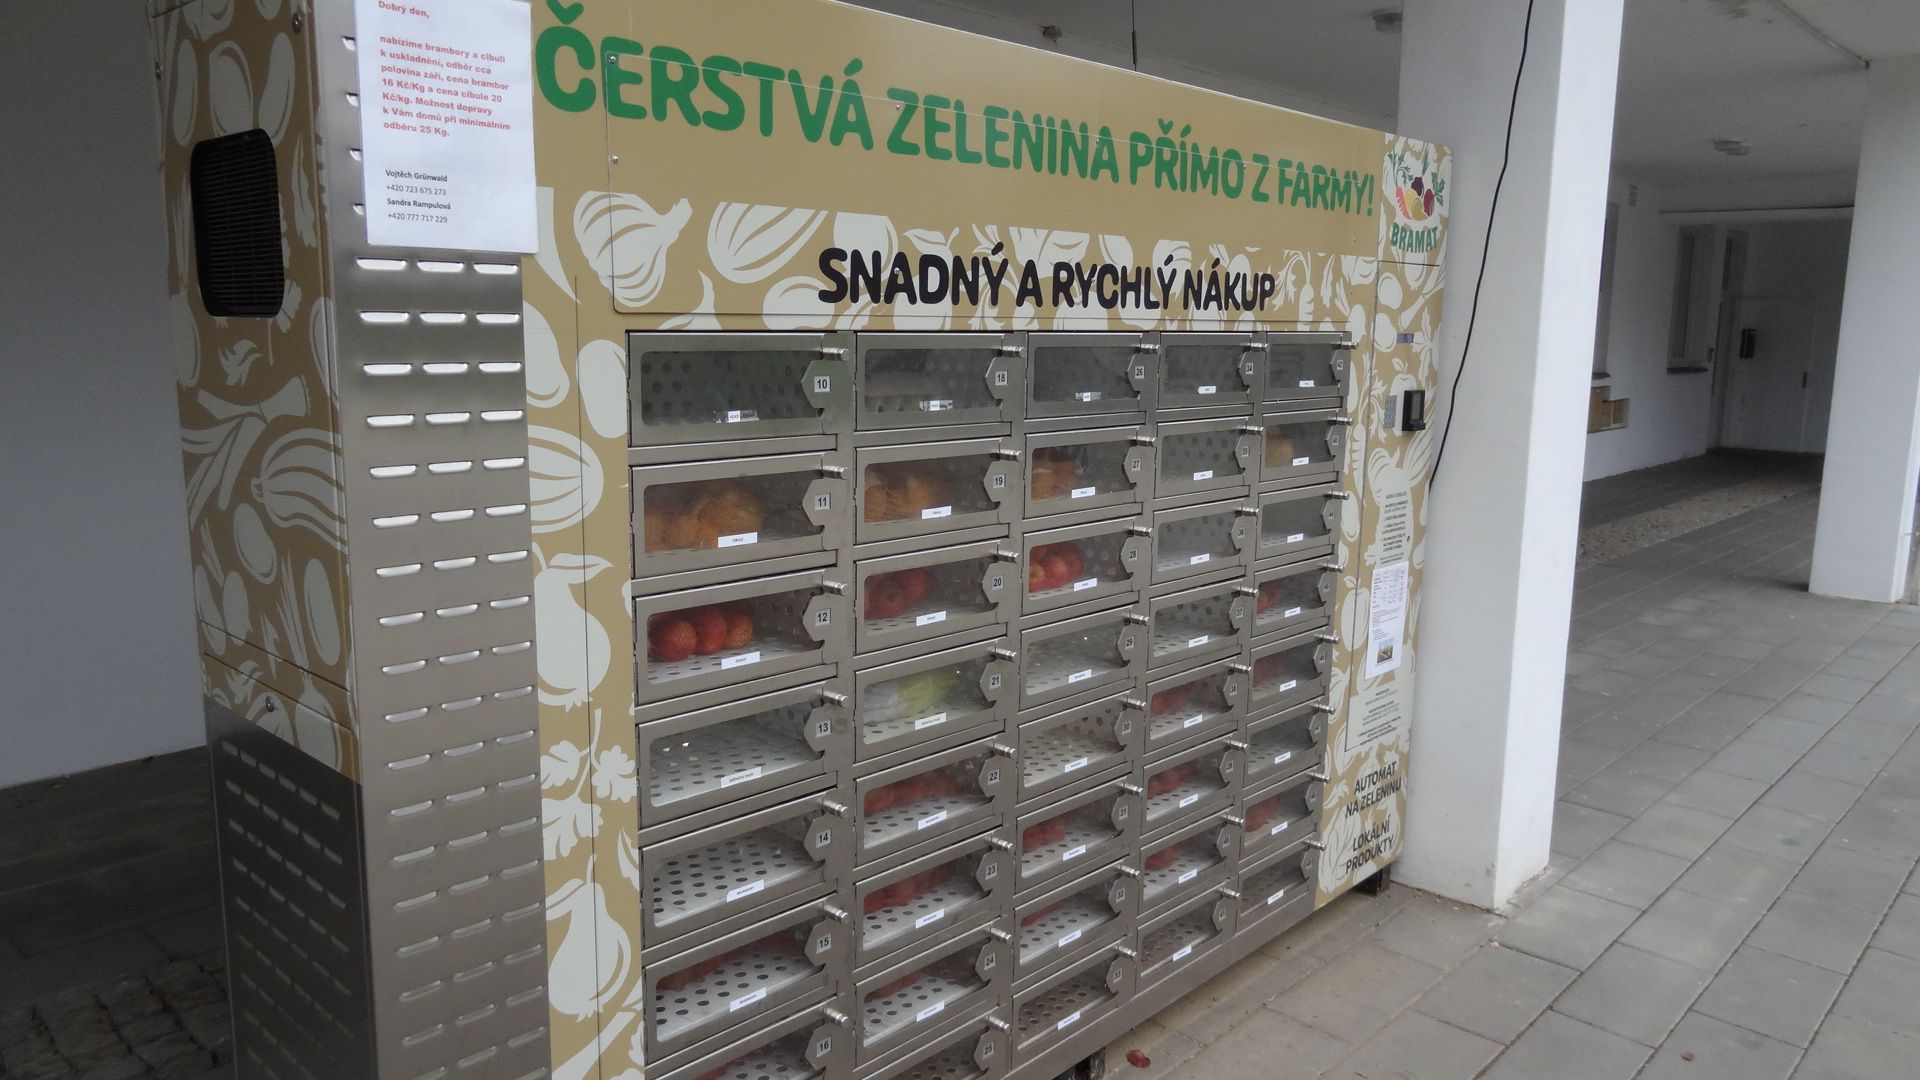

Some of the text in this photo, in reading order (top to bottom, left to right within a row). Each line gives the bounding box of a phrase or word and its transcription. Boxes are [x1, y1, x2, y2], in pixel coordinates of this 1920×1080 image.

[409, 8, 429, 19] den,
[425, 43, 470, 59] brambory
[481, 52, 506, 63] cibuli
[380, 49, 387, 57] k
[446, 60, 473, 72] odběr
[475, 66, 492, 75] cca
[381, 65, 421, 77] polovina
[446, 75, 469, 85] cena
[471, 78, 509, 91] brambor
[382, 78, 393, 87] 16
[436, 87, 459, 97] cena
[461, 90, 489, 102] cibule
[491, 94, 503, 103] 20
[415, 96, 454, 110] Možnost
[456, 103, 493, 116] dopravy
[535, 0, 1375, 217] ČERSTVÁ ZELENINA PŘÍMO Z FARMY!
[382, 106, 389, 114] k
[391, 107, 414, 118] Vám
[416, 111, 442, 122] domů
[444, 113, 457, 124] při
[420, 125, 432, 134] 25
[434, 127, 450, 138] Kg.
[385, 169, 448, 182] Vojtěch Grünwald
[386, 184, 447, 196] +420 723 675 273
[387, 198, 411, 207] Sandra
[388, 212, 448, 223] +420 777 717 229
[1391, 222, 1439, 254] BRAMAT
[817, 242, 1277, 312] SNADNÝ A RYCHLÝ NÁKUP
[817, 379, 828, 389] 10
[997, 373, 1006, 383] 18
[995, 476, 1003, 486] 19
[818, 496, 828, 508] 11
[993, 578, 1002, 589] 20
[817, 611, 828, 623] 12
[991, 675, 1000, 686] 21
[818, 722, 829, 734] 13
[990, 771, 998, 782] 22
[1354, 760, 1398, 796] AUTOMAT
[1345, 777, 1402, 819] NA ZELENINU
[819, 832, 830, 844] 14
[1352, 814, 1391, 853] LOKÁLNÍ
[1345, 834, 1395, 875] PRODUKTY
[987, 866, 996, 877] 23
[819, 937, 830, 949] 15
[985, 956, 994, 967] 24
[819, 1039, 830, 1051] 16
